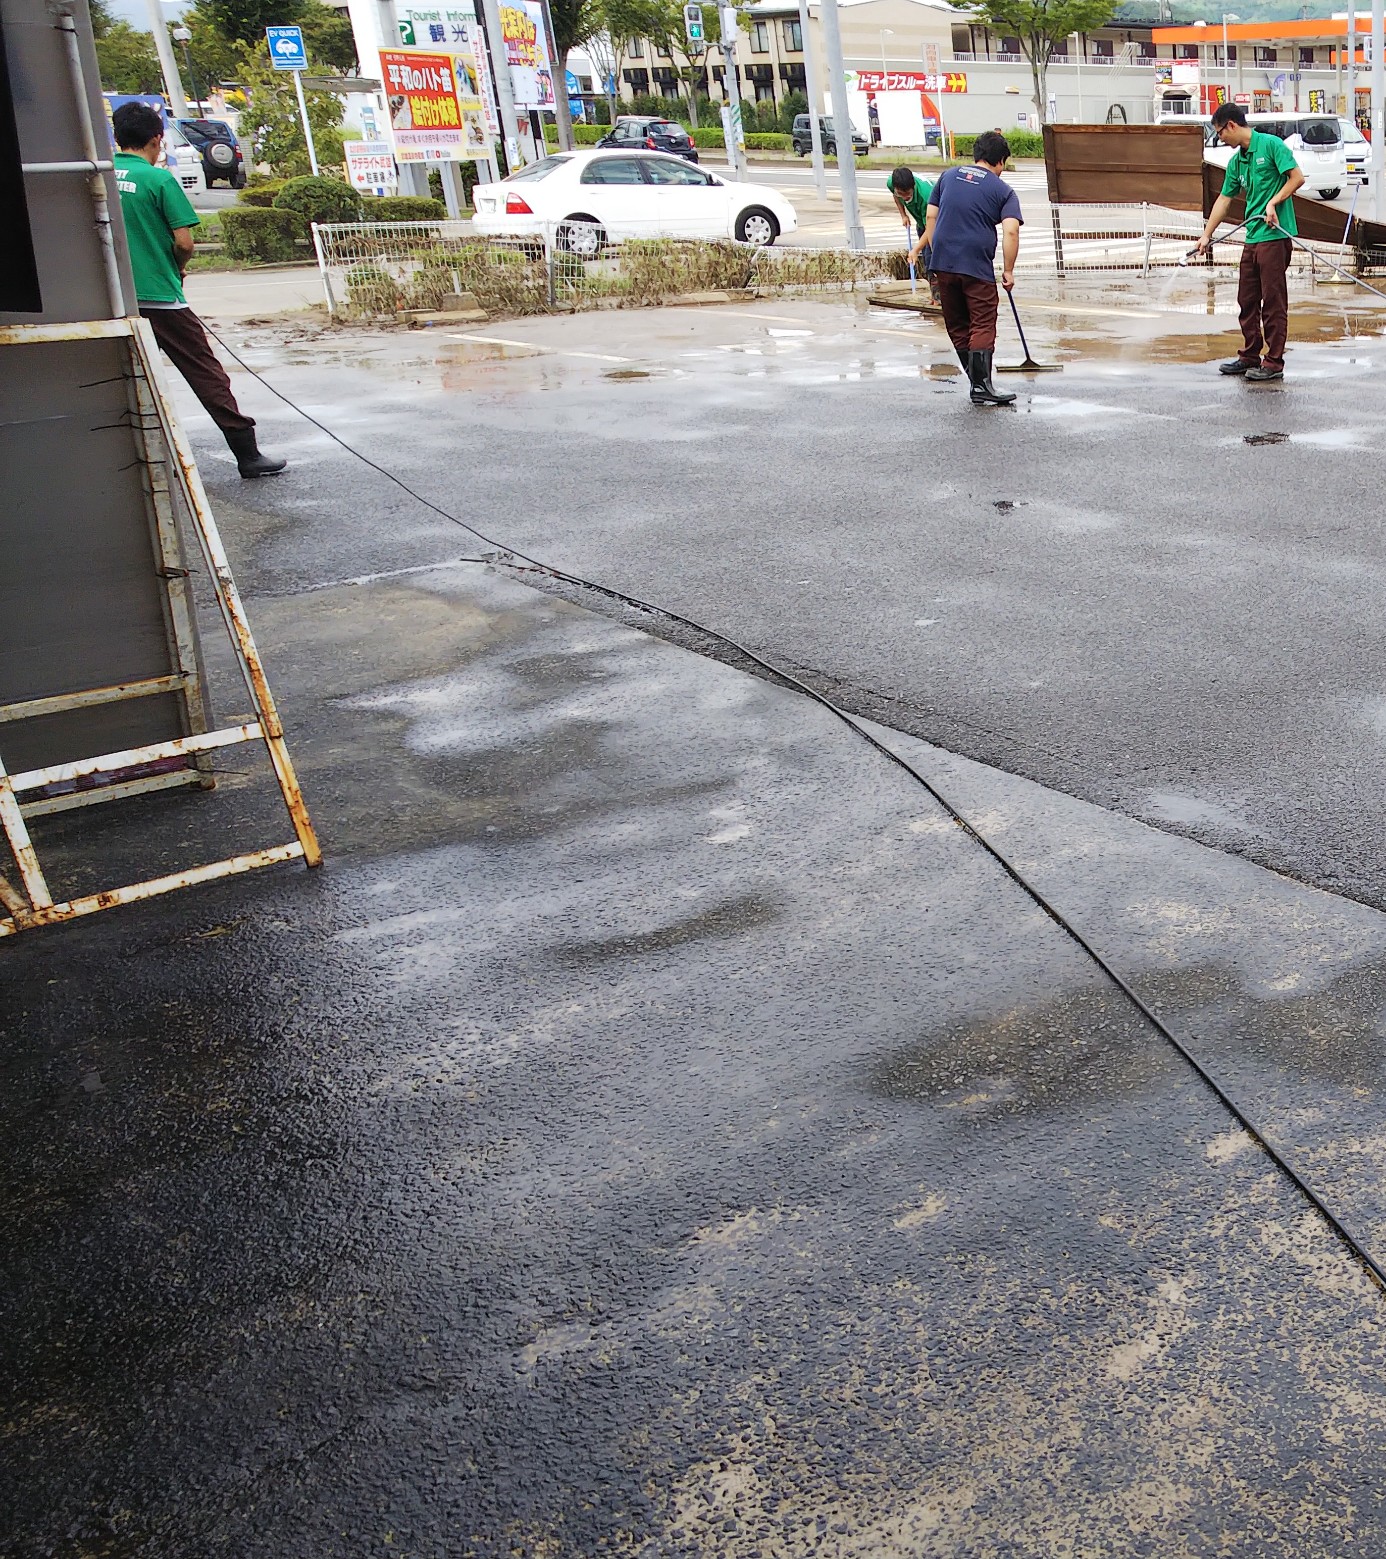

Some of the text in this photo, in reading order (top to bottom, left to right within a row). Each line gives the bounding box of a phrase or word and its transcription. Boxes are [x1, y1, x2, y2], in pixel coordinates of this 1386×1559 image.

[406, 10, 477, 21] Tourist Inform
[429, 24, 468, 42] 観光
[387, 64, 453, 92] 平和のハト笛
[410, 95, 459, 126] 絵付け体験
